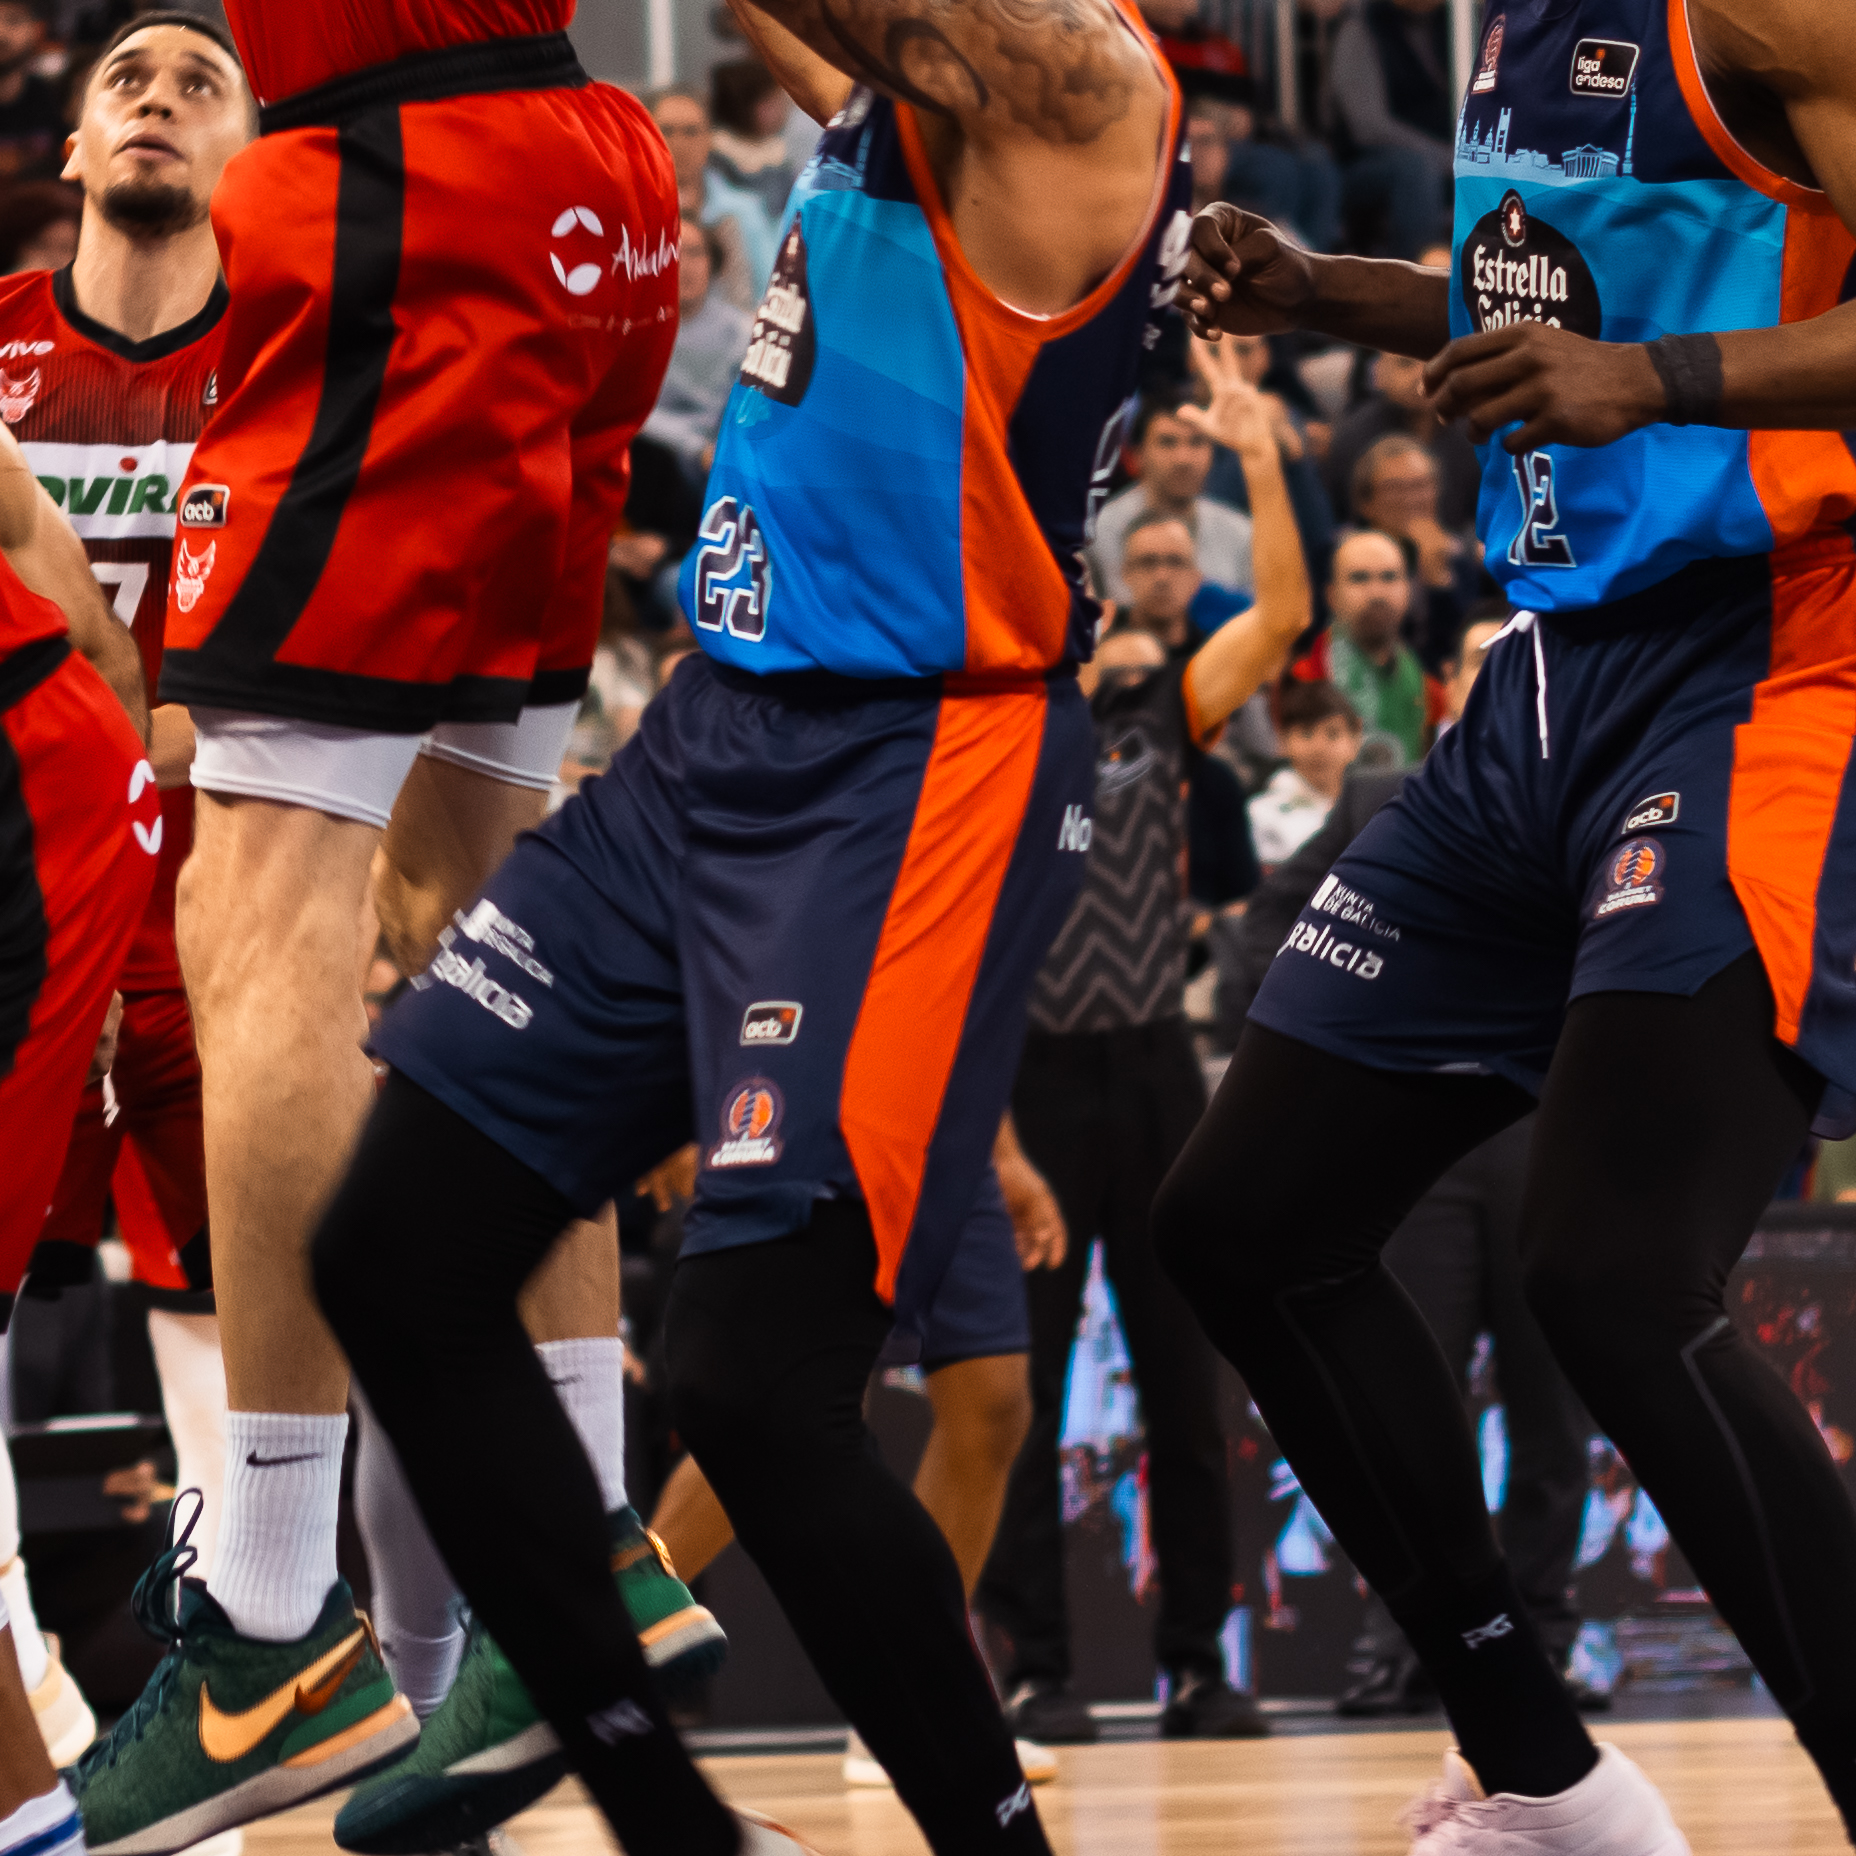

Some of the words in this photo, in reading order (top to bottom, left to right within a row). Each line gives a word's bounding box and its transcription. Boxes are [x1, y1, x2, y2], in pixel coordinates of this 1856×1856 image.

[1577, 55, 1601, 74] liga
[1575, 72, 1625, 90] endesa
[1473, 244, 1569, 302] Estrella
[1478, 294, 1562, 334] Galia
[184, 500, 215, 522] acb
[696, 495, 771, 643] 23
[1627, 806, 1664, 829] acb
[1275, 920, 1384, 980] galicia
[745, 1017, 783, 1039] acb
